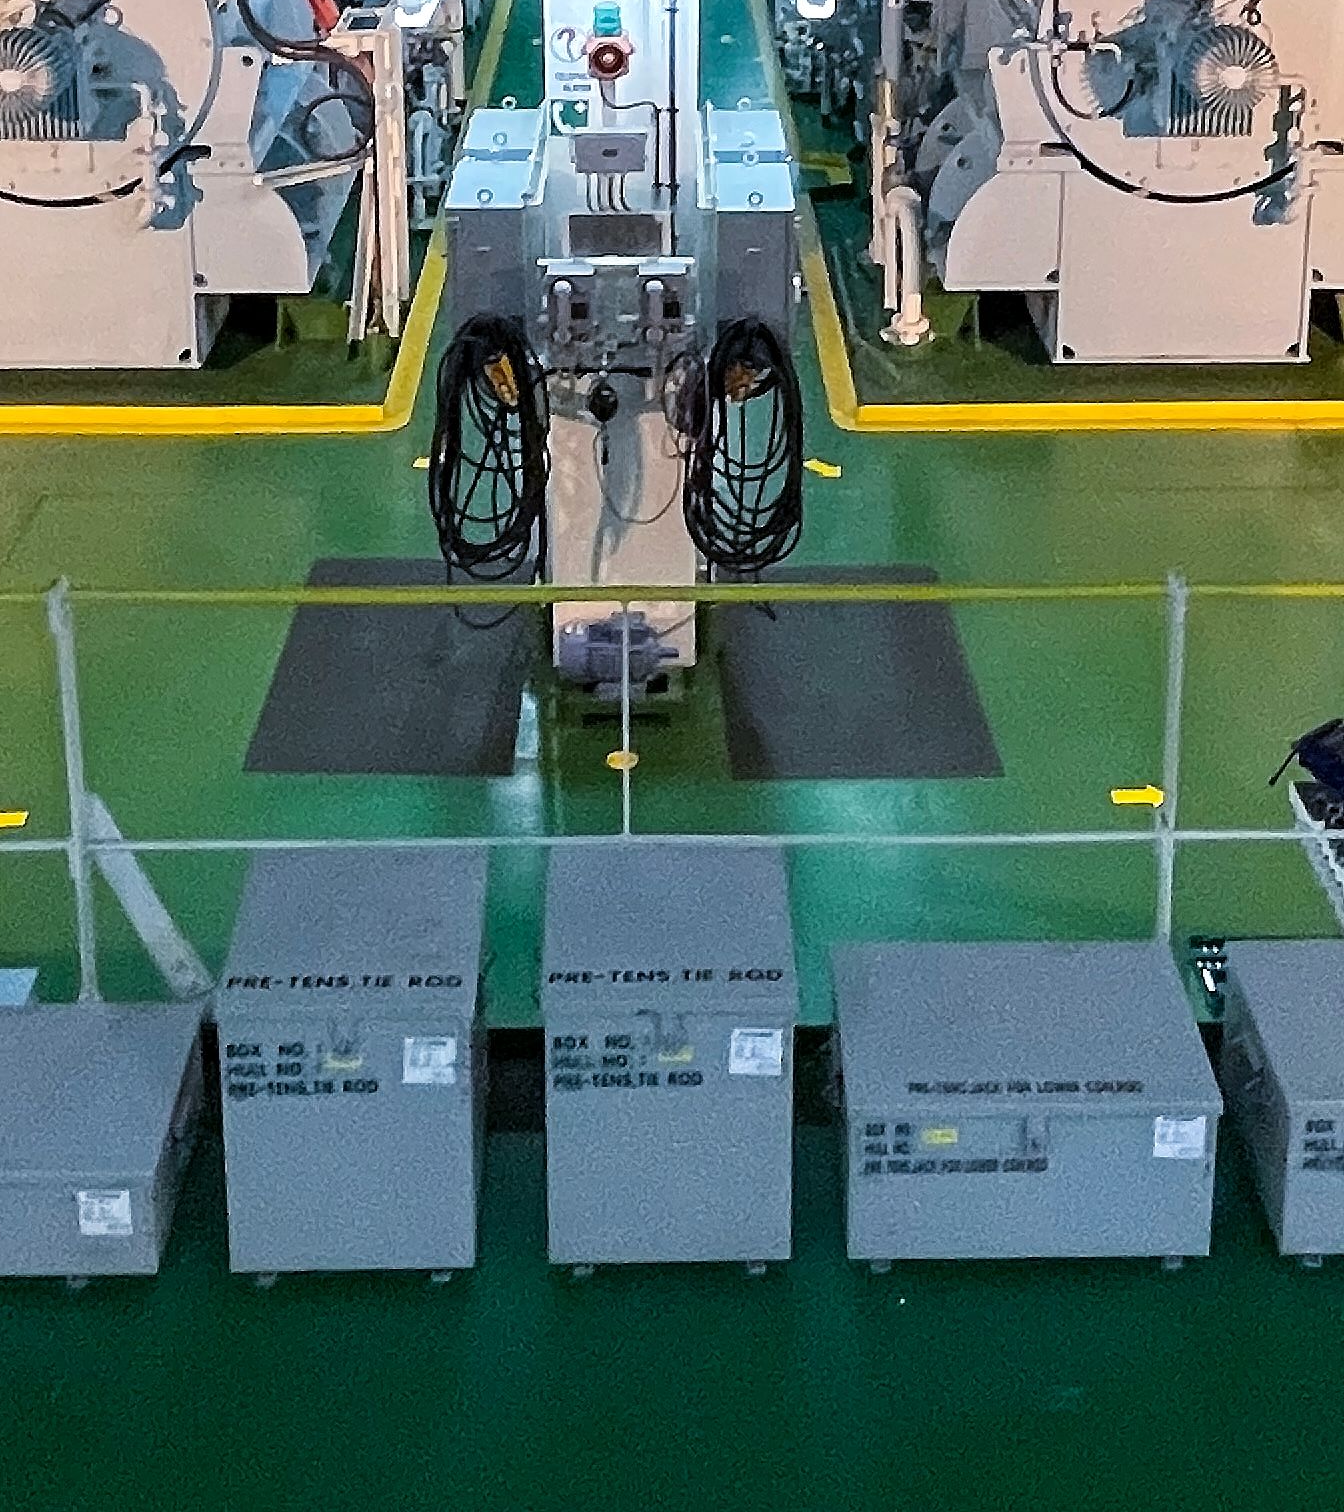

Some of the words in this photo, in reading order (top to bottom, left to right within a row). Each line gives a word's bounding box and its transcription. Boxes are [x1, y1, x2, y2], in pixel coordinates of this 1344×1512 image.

[407, 974, 463, 988] ROD
[727, 968, 785, 983] ROD
[552, 1035, 590, 1050] BOX
[225, 1043, 262, 1058] BOX
[341, 1078, 380, 1094] ROD
[667, 1070, 705, 1087] ROD
